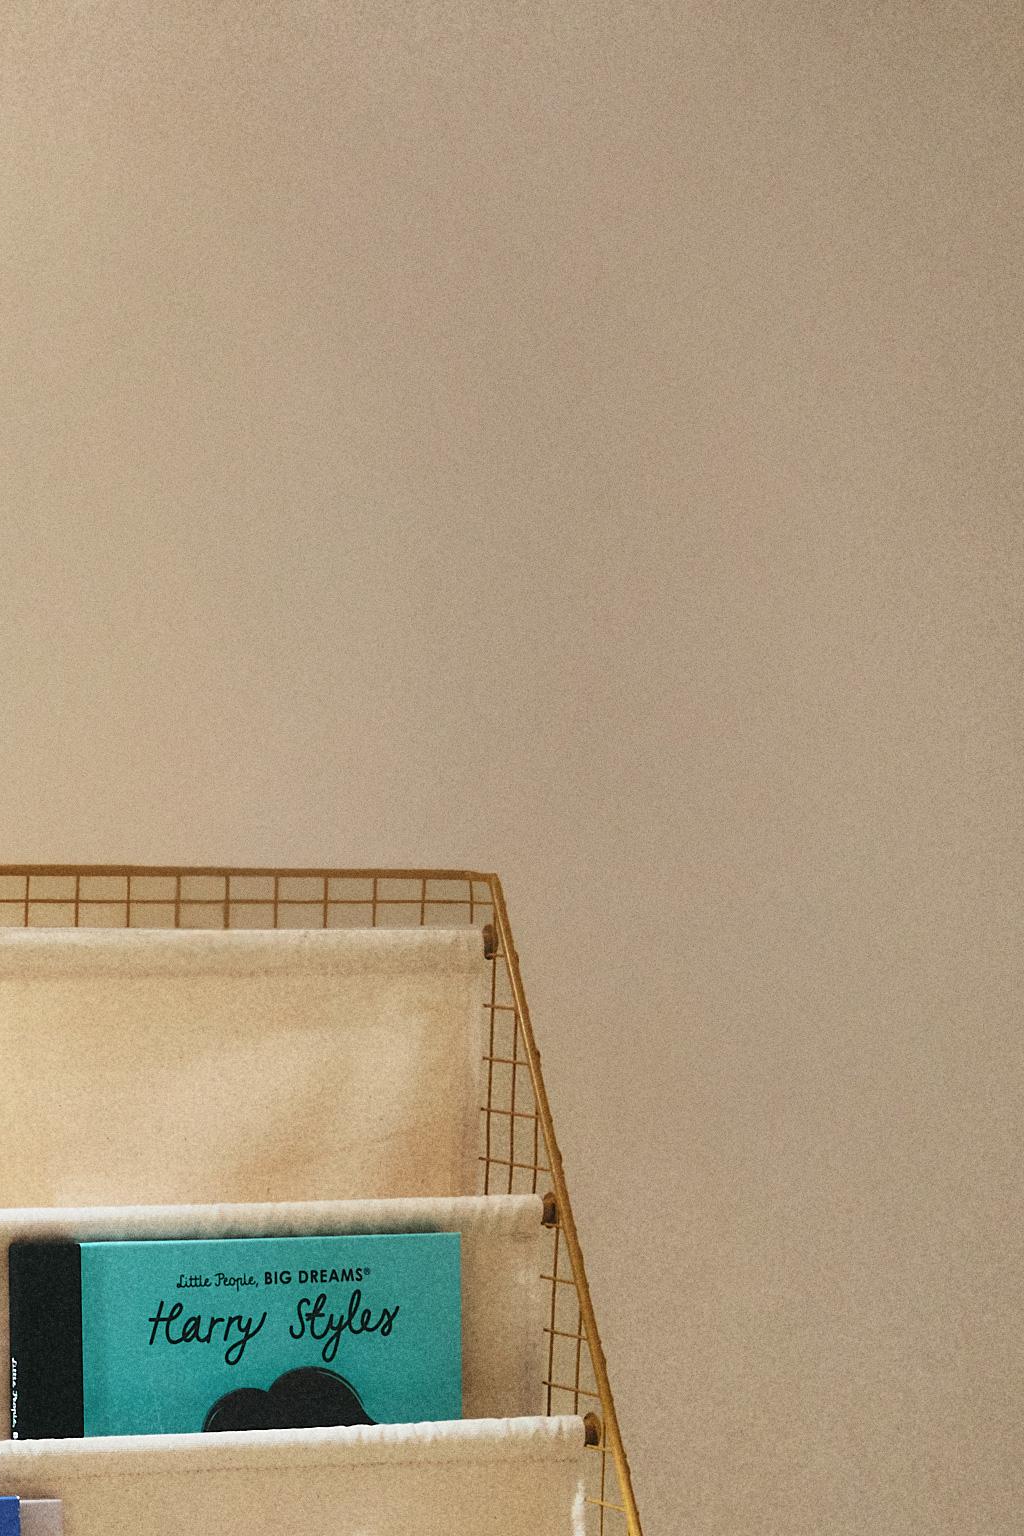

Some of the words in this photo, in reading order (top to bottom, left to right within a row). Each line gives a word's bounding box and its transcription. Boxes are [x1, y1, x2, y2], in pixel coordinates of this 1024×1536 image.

[176, 1274, 212, 1289] Little
[214, 1272, 259, 1292] People,
[264, 1270, 292, 1285] BIG
[148, 1300, 268, 1366] Harry
[289, 1289, 400, 1363] Styles
